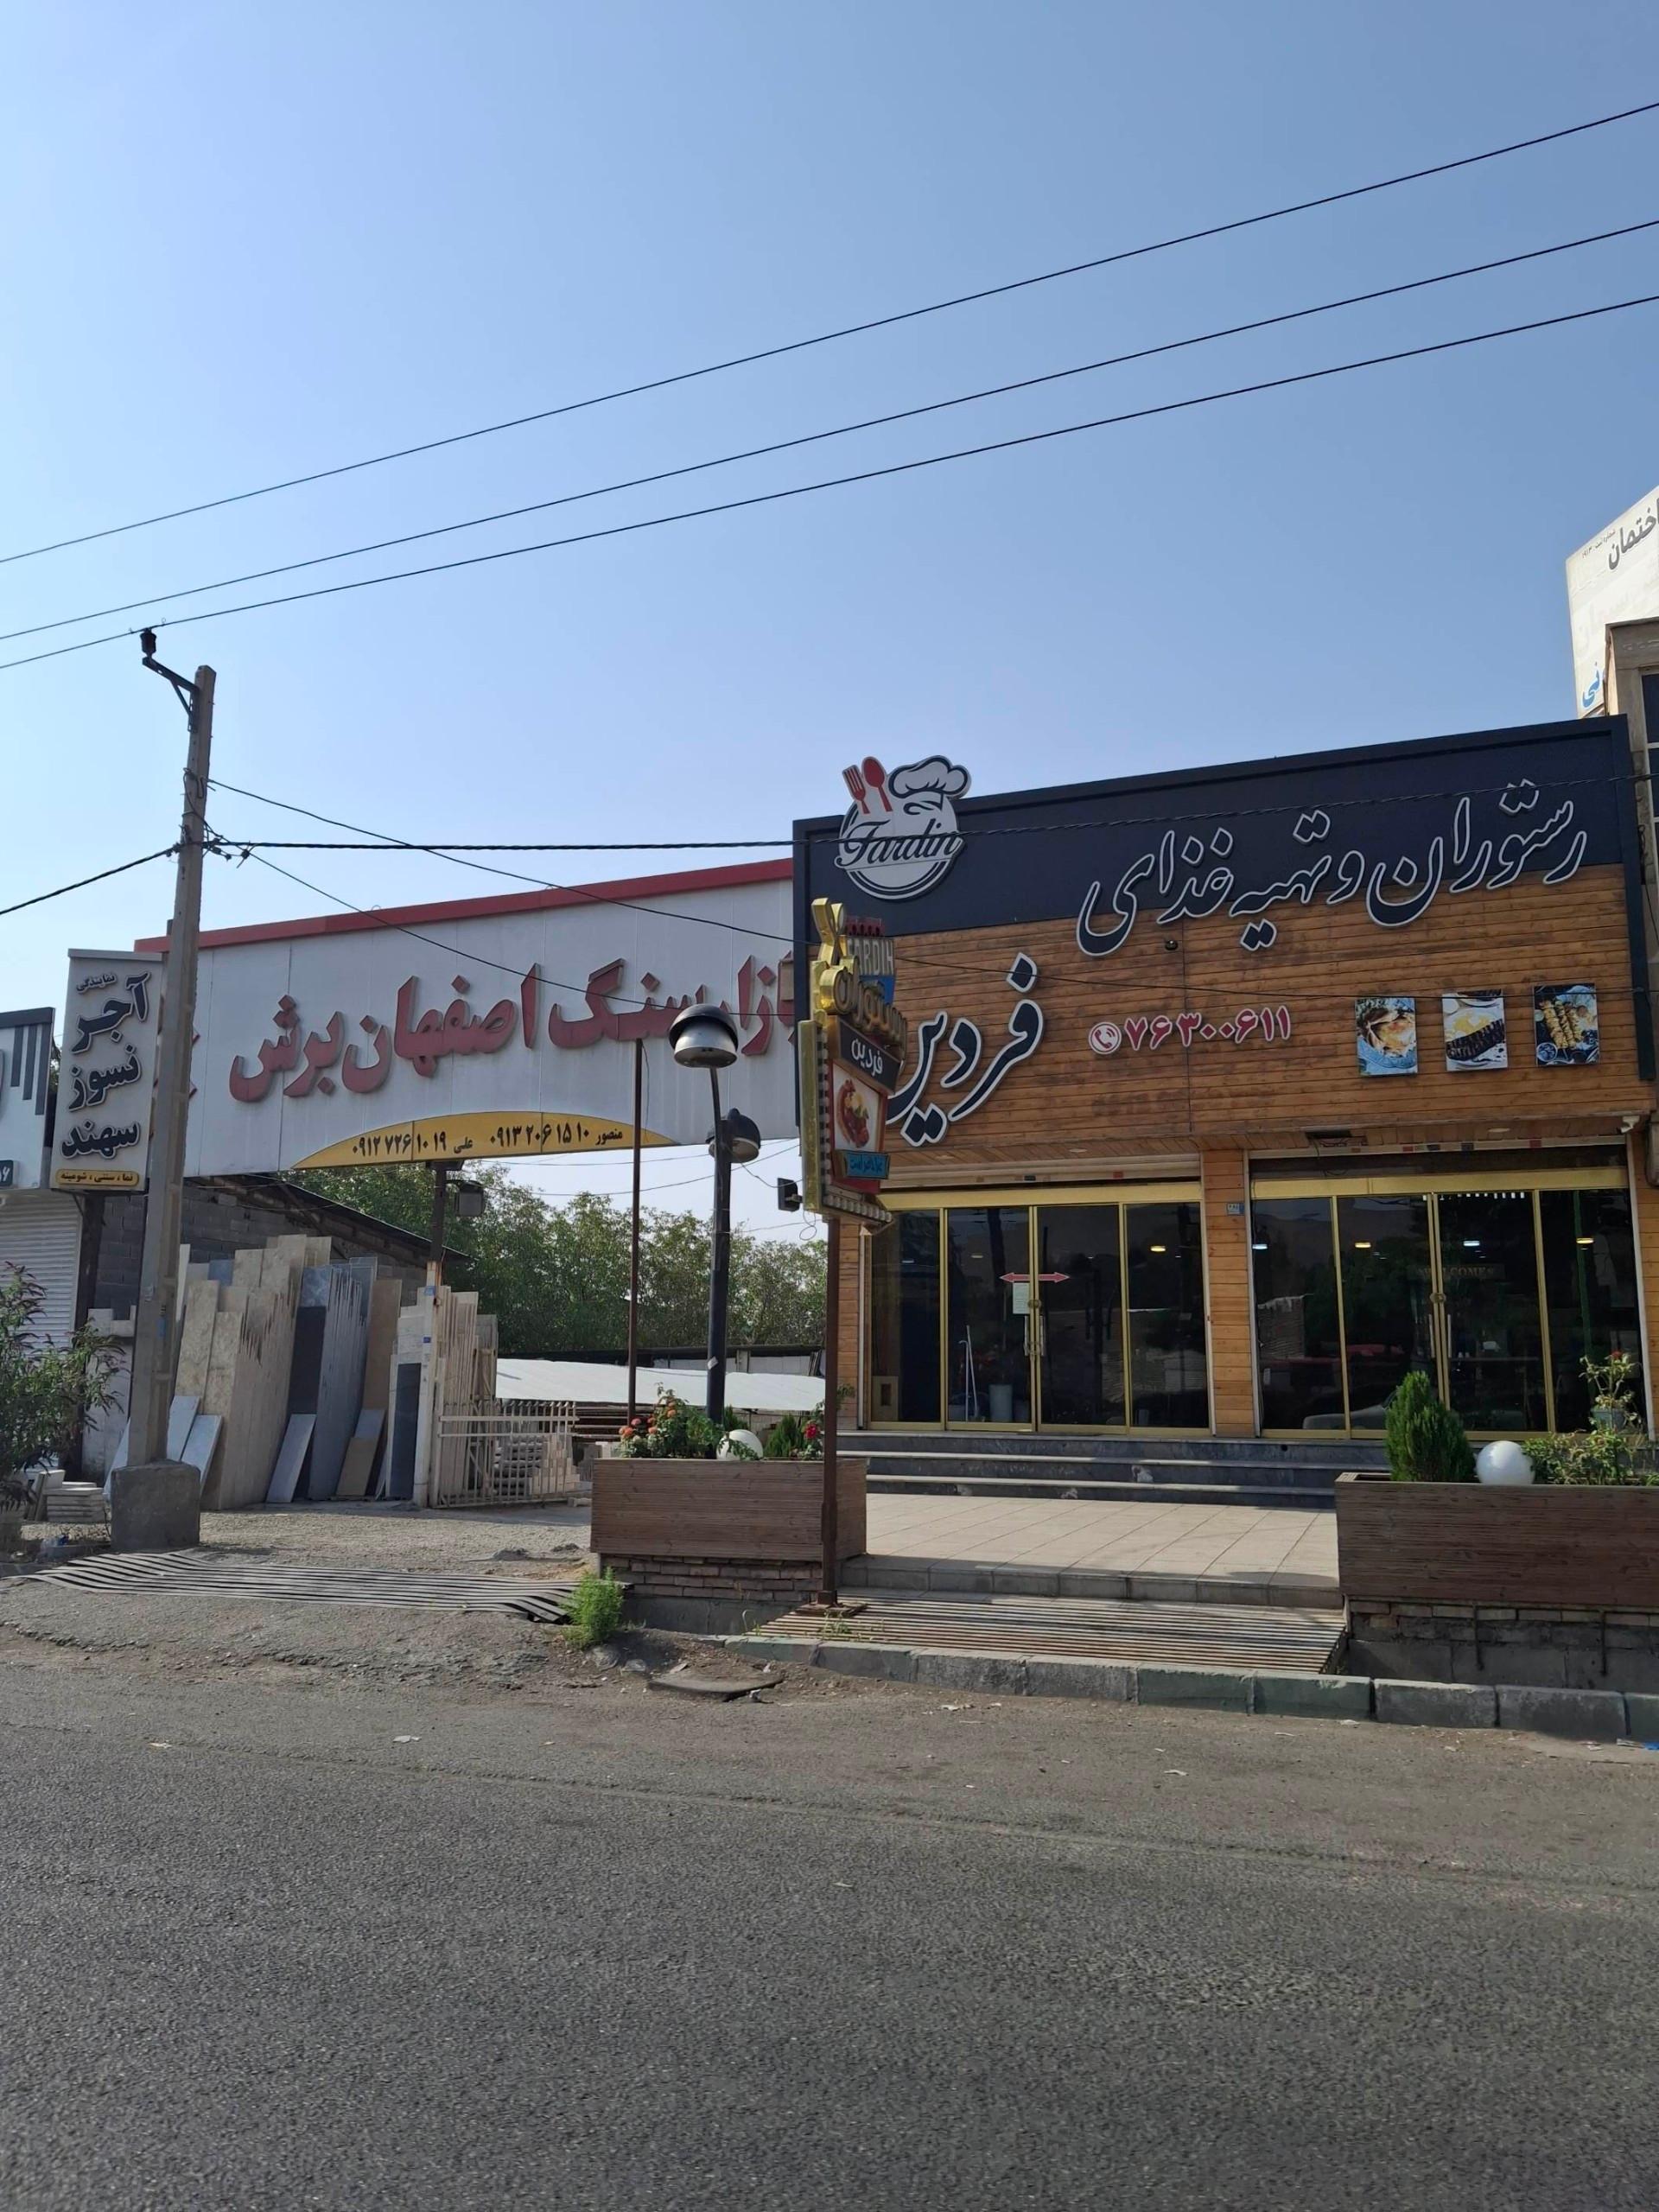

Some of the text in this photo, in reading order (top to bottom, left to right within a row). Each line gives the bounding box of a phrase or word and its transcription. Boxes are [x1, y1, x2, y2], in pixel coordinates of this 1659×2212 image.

[836, 817, 963, 867] Fardin
[1077, 779, 1587, 957] رستوران و تهیه غذای
[76, 972, 118, 995] نمایندگی
[71, 969, 150, 1054] آجر
[341, 962, 542, 1093] اصفهان
[1124, 1005, 1292, 1052] ۷۶۳۰۰۶۱۱
[229, 995, 345, 1103] برش
[850, 1038, 884, 1077] فردین
[68, 1043, 142, 1112] نسوز
[60, 1119, 140, 1159] سهند
[454, 1136, 474, 1154] علی
[594, 1127, 624, 1147] منصور
